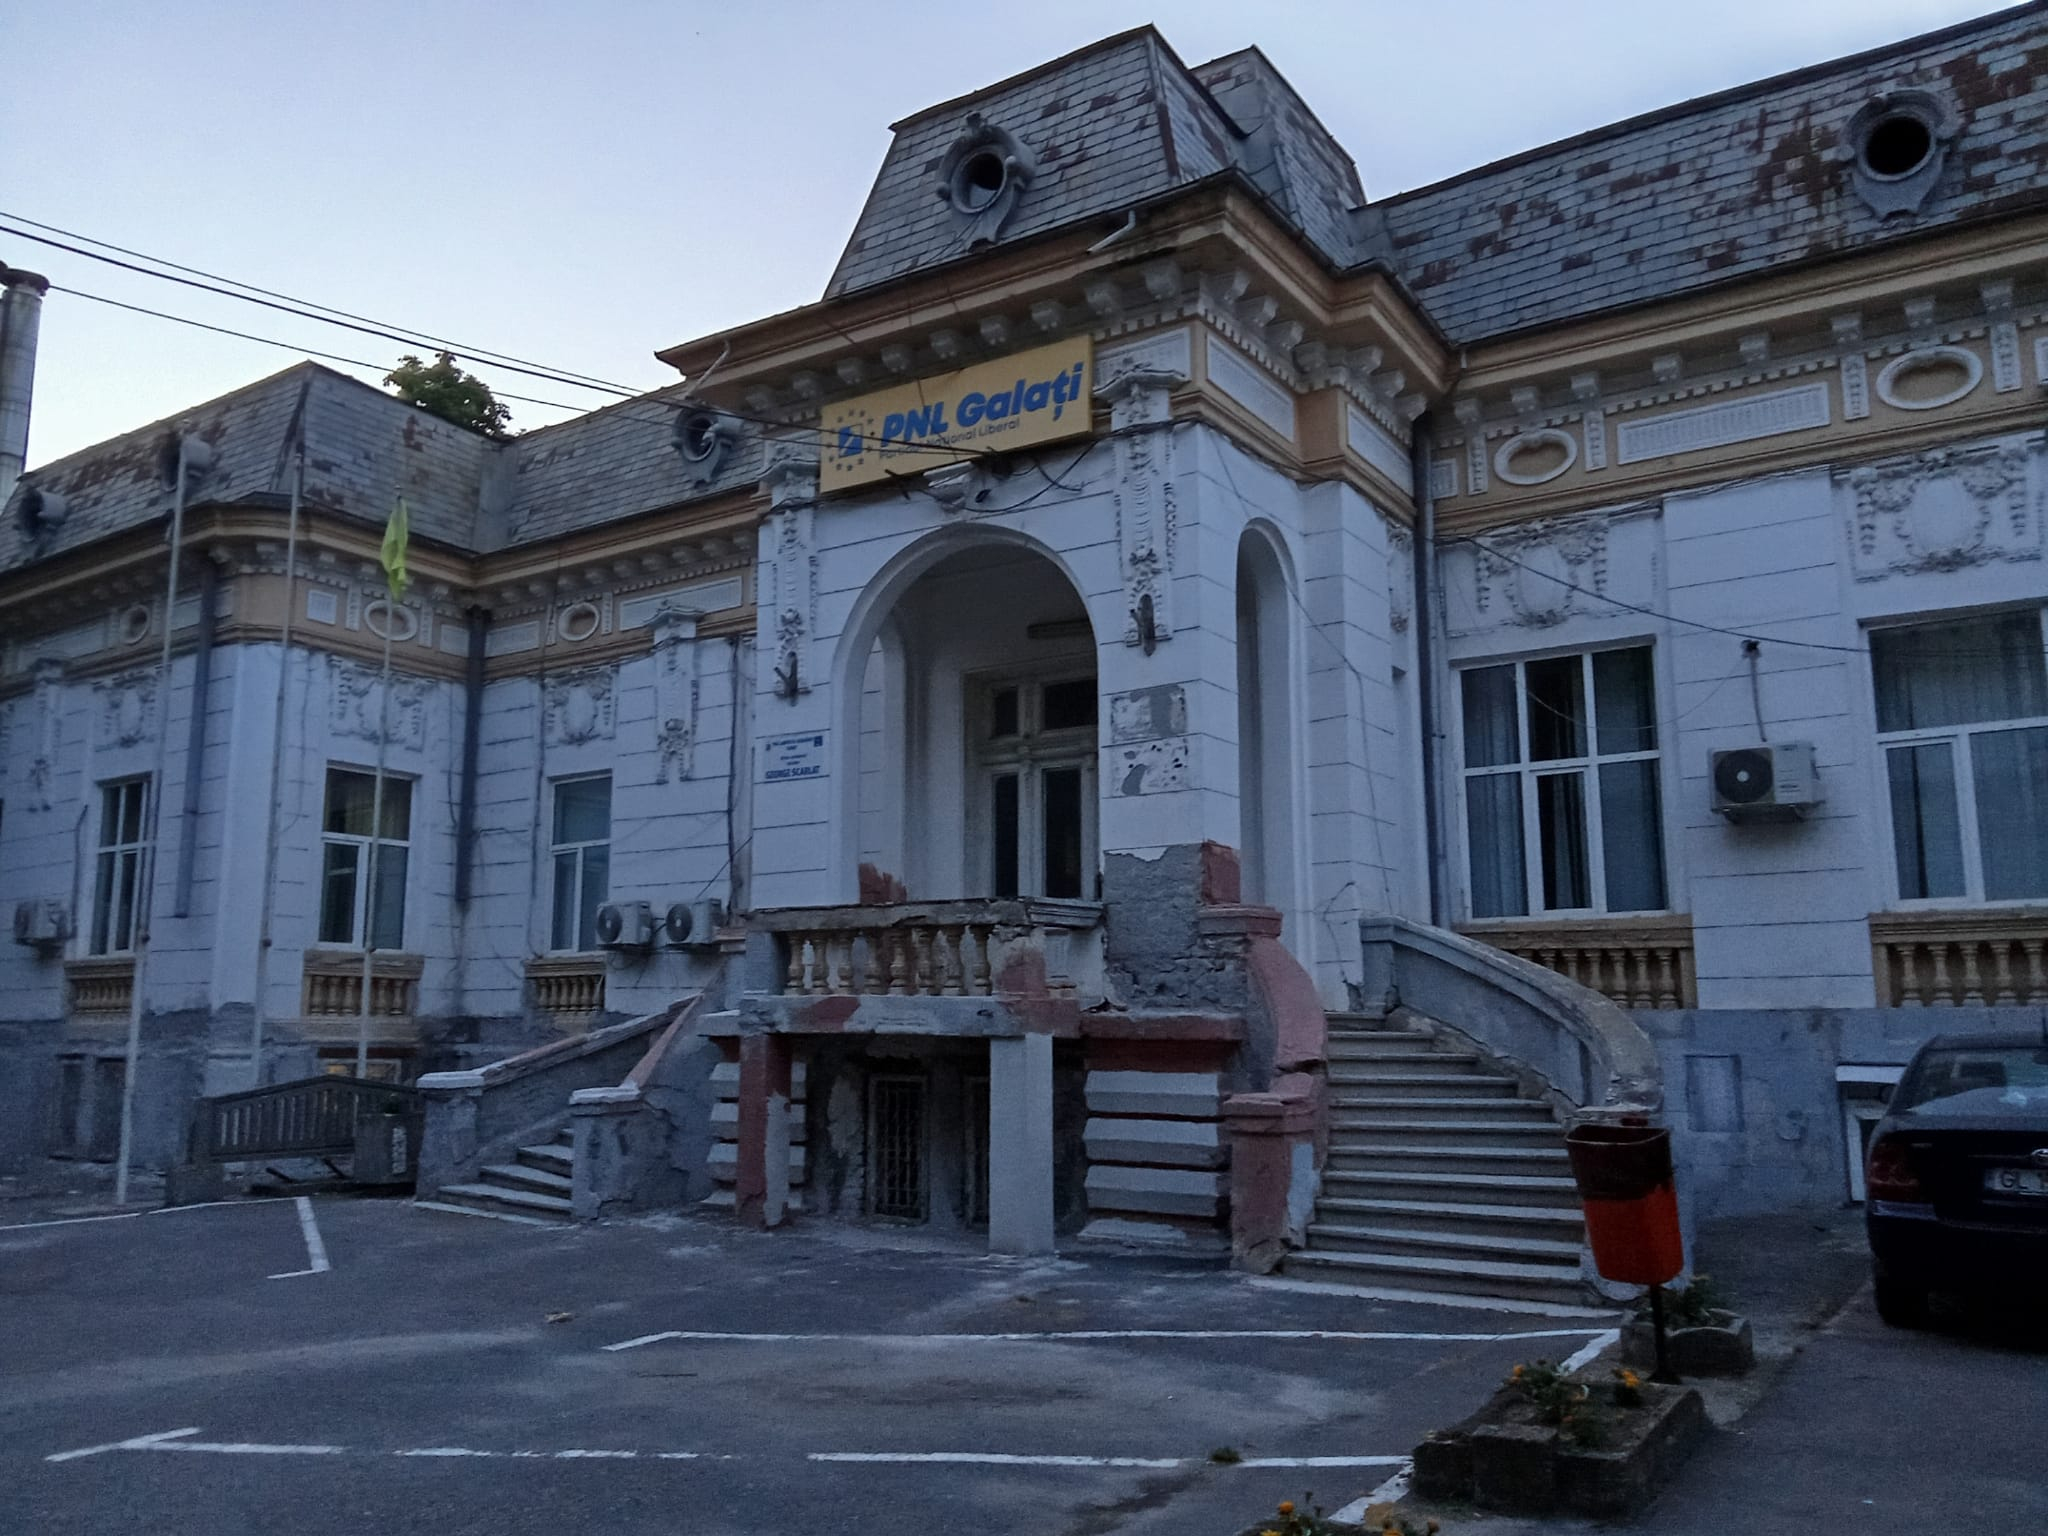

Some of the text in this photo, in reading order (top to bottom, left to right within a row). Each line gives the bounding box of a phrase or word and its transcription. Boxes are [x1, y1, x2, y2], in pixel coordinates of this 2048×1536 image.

[881, 401, 948, 448] PNL
[978, 418, 1020, 437] Liberal
[791, 765, 820, 777] SCARLAT
[2000, 1170, 2028, 1189] GL
